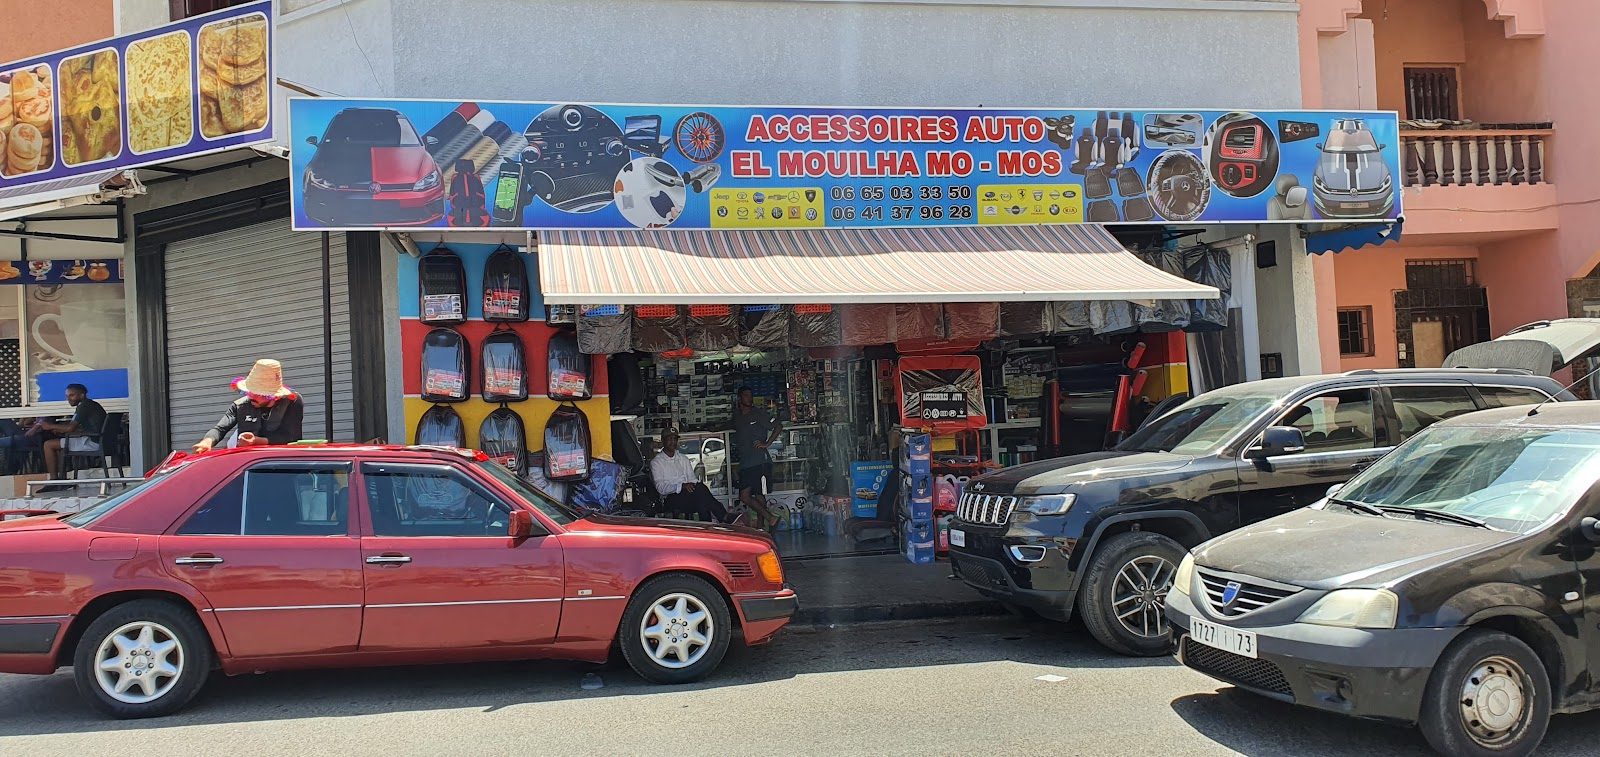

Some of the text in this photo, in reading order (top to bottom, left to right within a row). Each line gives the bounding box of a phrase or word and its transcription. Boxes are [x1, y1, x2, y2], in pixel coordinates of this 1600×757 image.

[746, 115, 1046, 142] ACCESSOIRES AUTO
[731, 151, 771, 176] EL
[779, 151, 921, 177] MOUILHA
[927, 152, 974, 177] MO
[997, 151, 1063, 176] MOS
[714, 193, 730, 201] Jeep
[831, 185, 971, 200] 06 65 03 33 50
[832, 205, 972, 220] 06 41 37 96 28
[1193, 621, 1215, 643] 1727
[1237, 633, 1251, 653] 73
